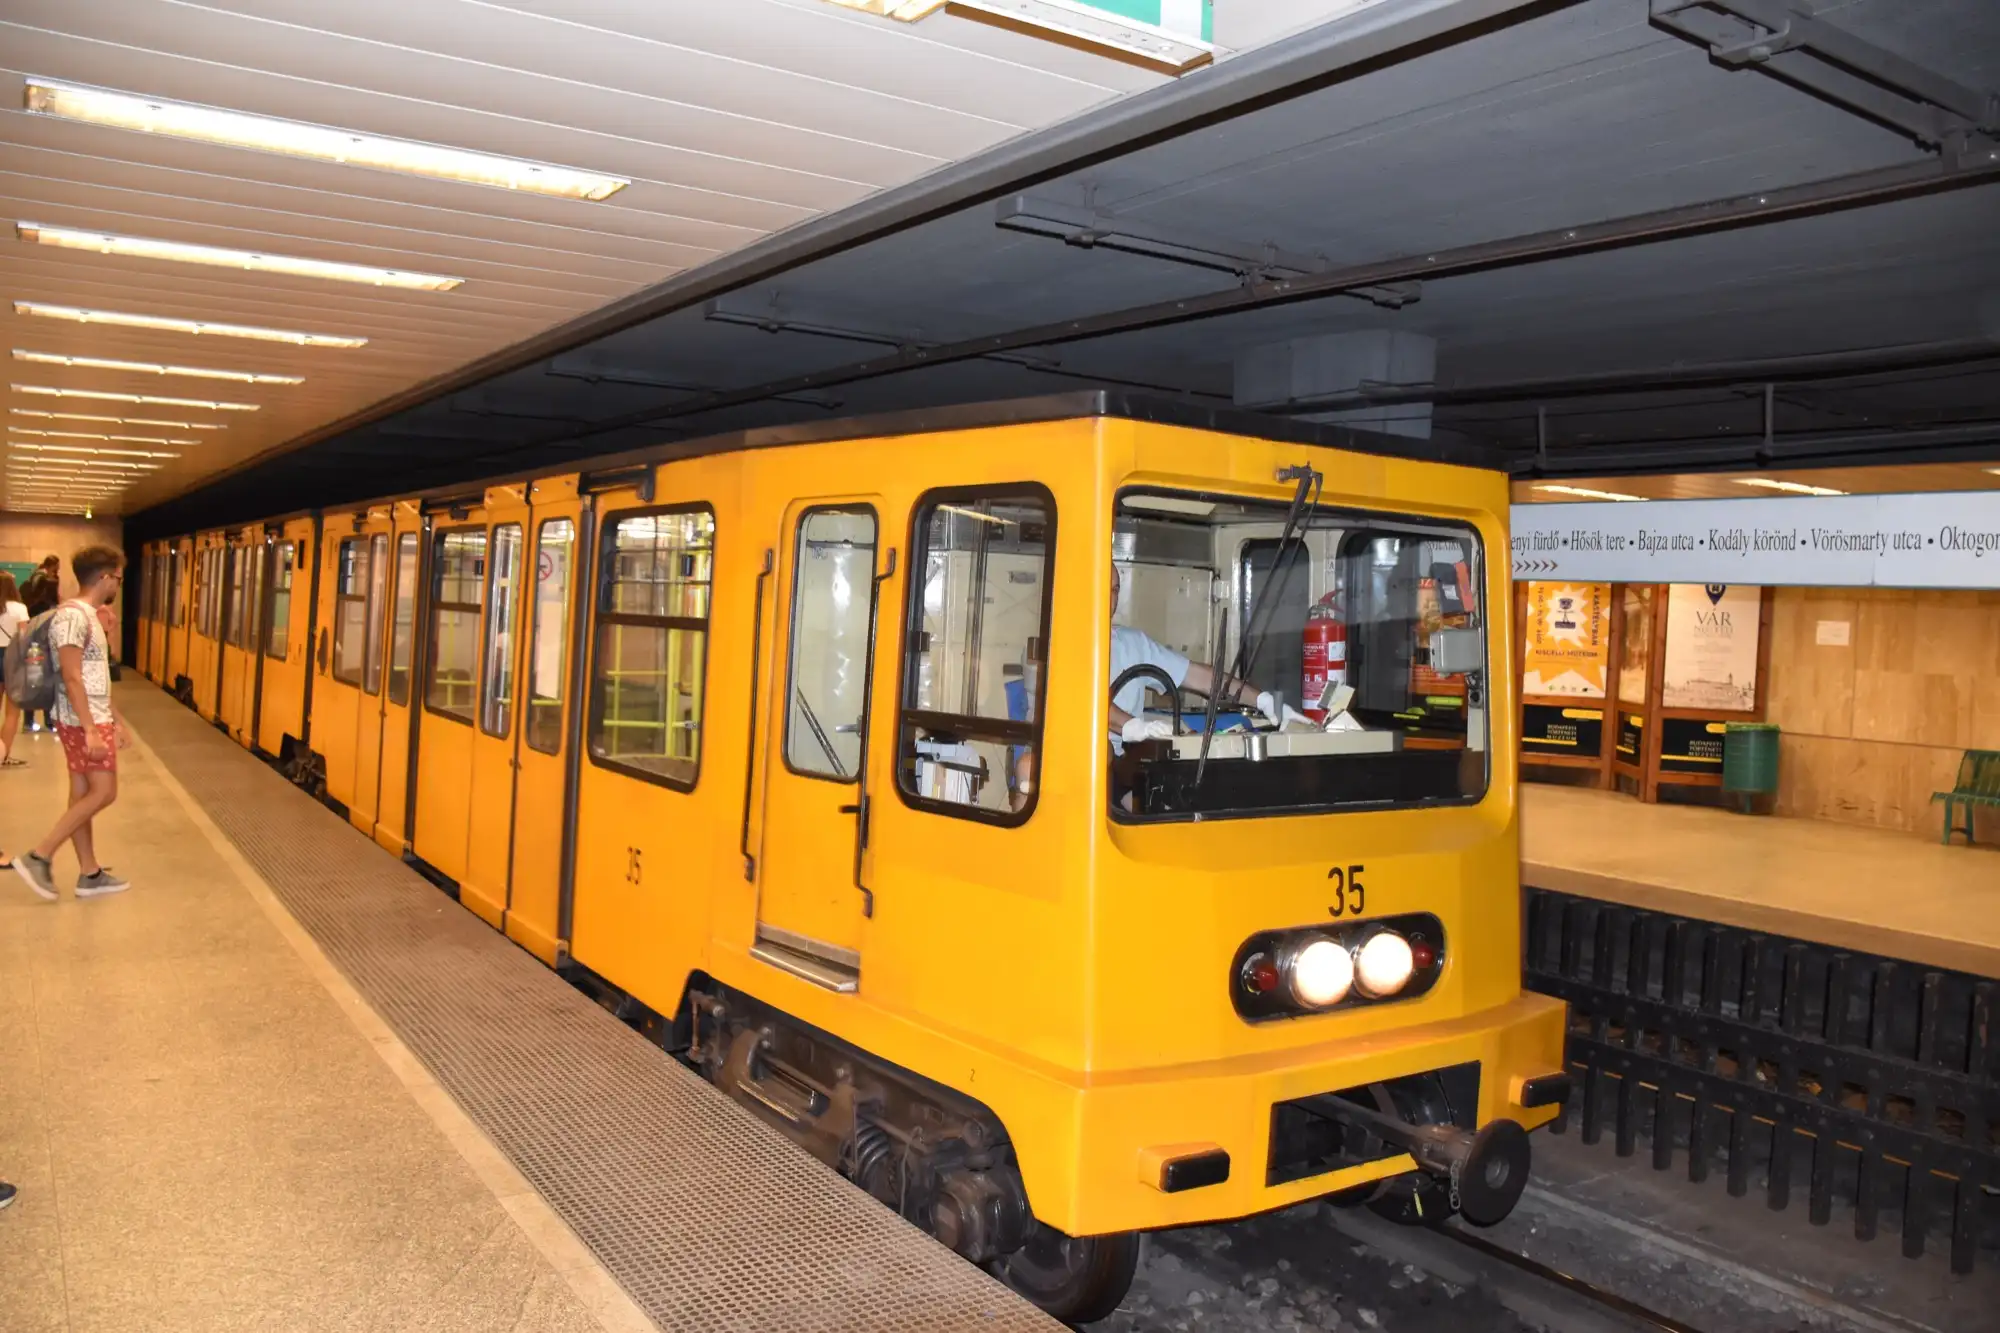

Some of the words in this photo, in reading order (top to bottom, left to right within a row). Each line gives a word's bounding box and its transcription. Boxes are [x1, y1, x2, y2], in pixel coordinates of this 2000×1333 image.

[1533, 530, 1559, 550] fürdő
[1571, 530, 1602, 551] Hősök
[1606, 533, 1625, 550] tere
[1638, 529, 1668, 556] Bajza
[1671, 532, 1694, 550] utca
[1709, 528, 1749, 556] Kodály
[1753, 528, 1796, 550] körönd
[1811, 528, 1888, 556] Vörösmarty
[1893, 530, 1922, 550] utca
[1696, 607, 1731, 626] VÁR
[1328, 865, 1364, 917] 35
